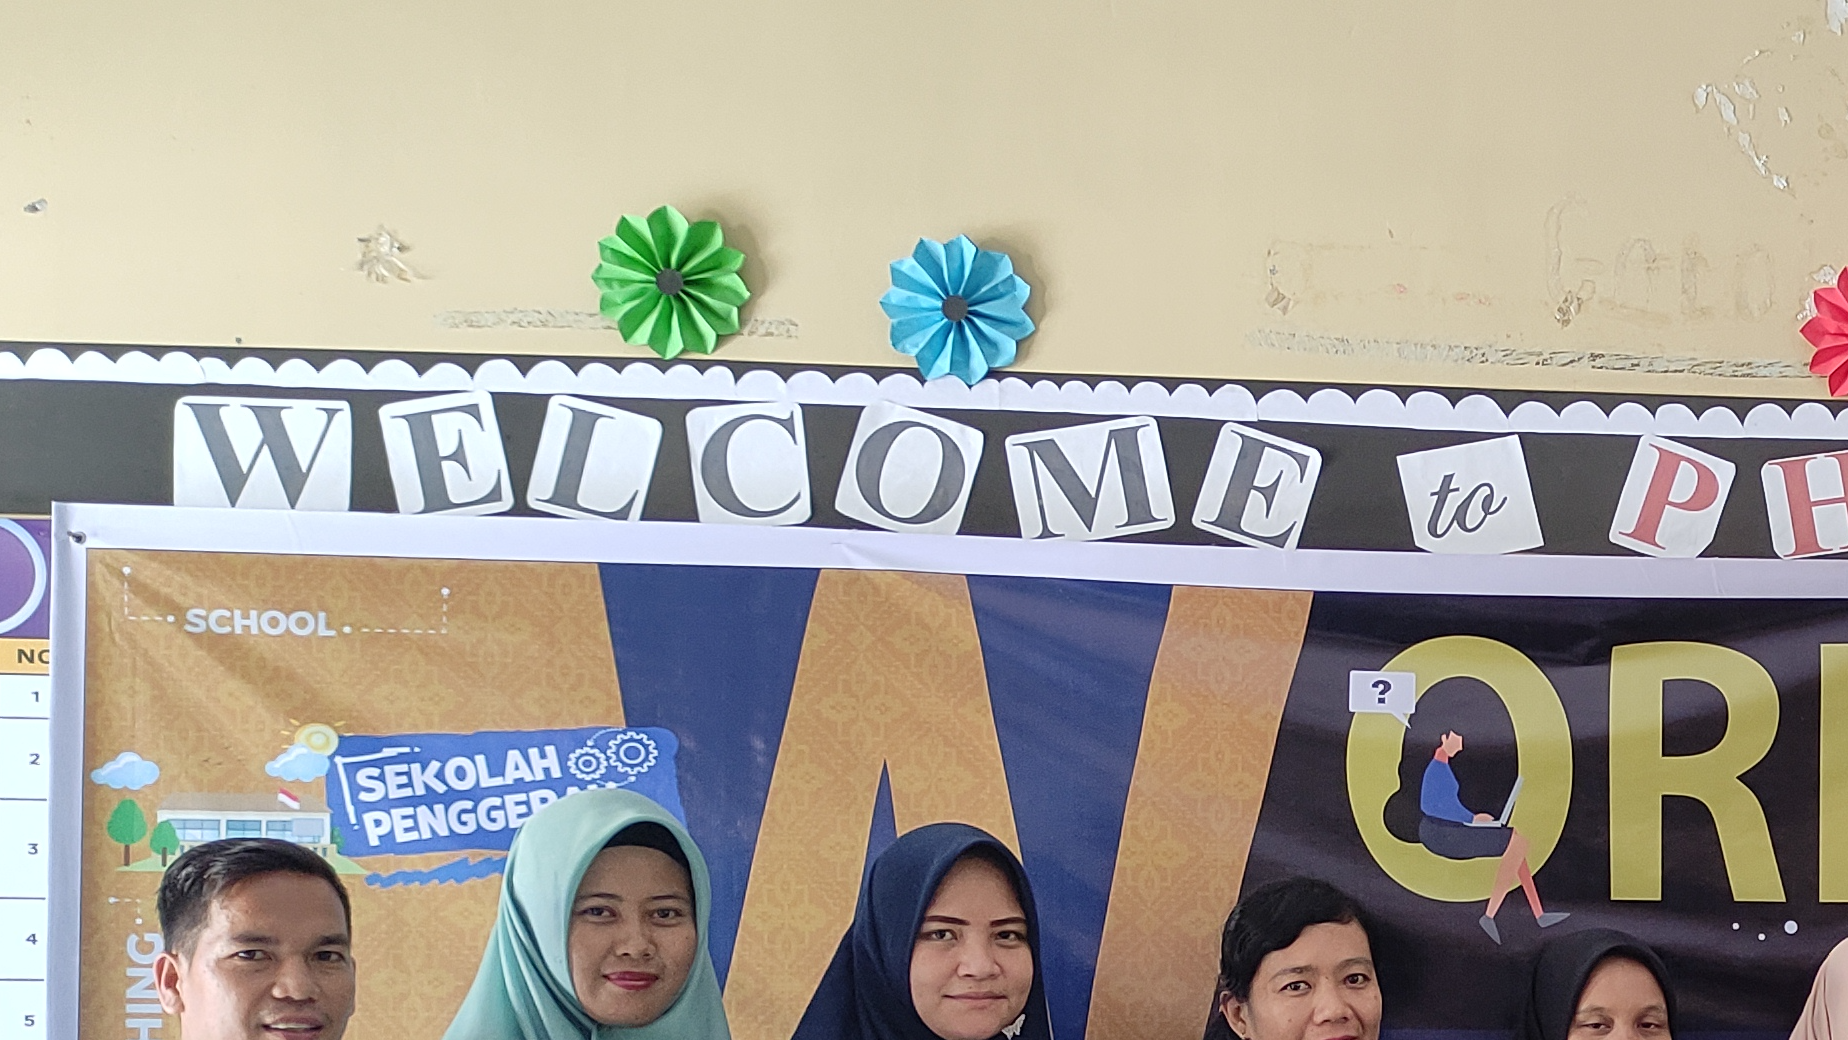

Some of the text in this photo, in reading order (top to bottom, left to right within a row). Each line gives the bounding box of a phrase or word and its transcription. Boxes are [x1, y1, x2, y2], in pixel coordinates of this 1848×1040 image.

[182, 402, 1319, 548] WELCOME
[1427, 473, 1507, 538] to
[184, 607, 336, 638] SCHOOL
[31, 691, 39, 702] 1
[29, 753, 40, 765] 2
[356, 745, 562, 802] SEKOLAH
[27, 844, 38, 855] 3
[25, 933, 38, 946] 4
[24, 1015, 35, 1027] 5
